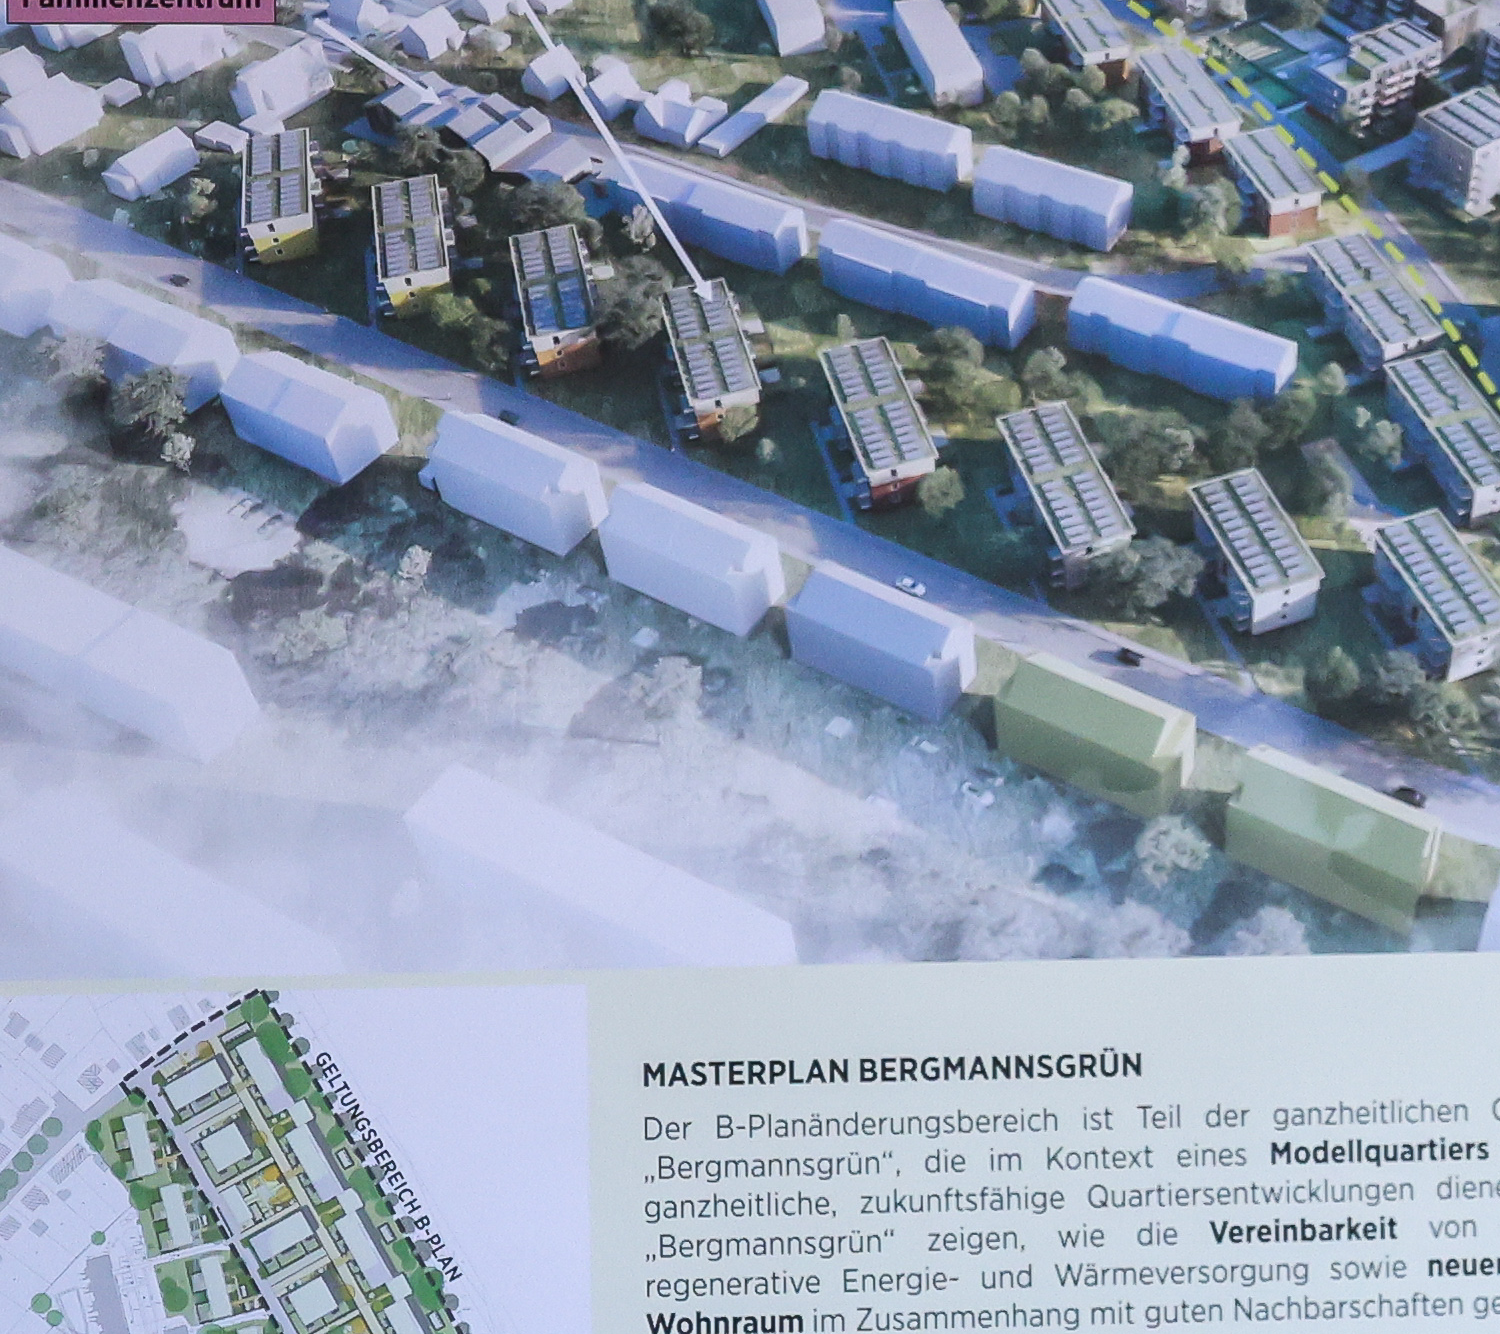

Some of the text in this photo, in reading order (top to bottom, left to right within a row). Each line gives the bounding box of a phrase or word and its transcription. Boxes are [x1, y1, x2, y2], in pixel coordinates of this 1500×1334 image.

[643, 1052, 1142, 1088] MASTERPLAN BERGMANNSGRÜN
[643, 1116, 693, 1141] Der
[716, 1107, 1059, 1140] B-Planänderungsbereich
[1083, 1107, 1114, 1131] ist
[1136, 1103, 1181, 1130] Teil
[1205, 1103, 1251, 1129] der
[1273, 1099, 1469, 1132] ganzheitlichen
[315, 1051, 464, 1283] GELTUNGSBEREICH B-PLAN
